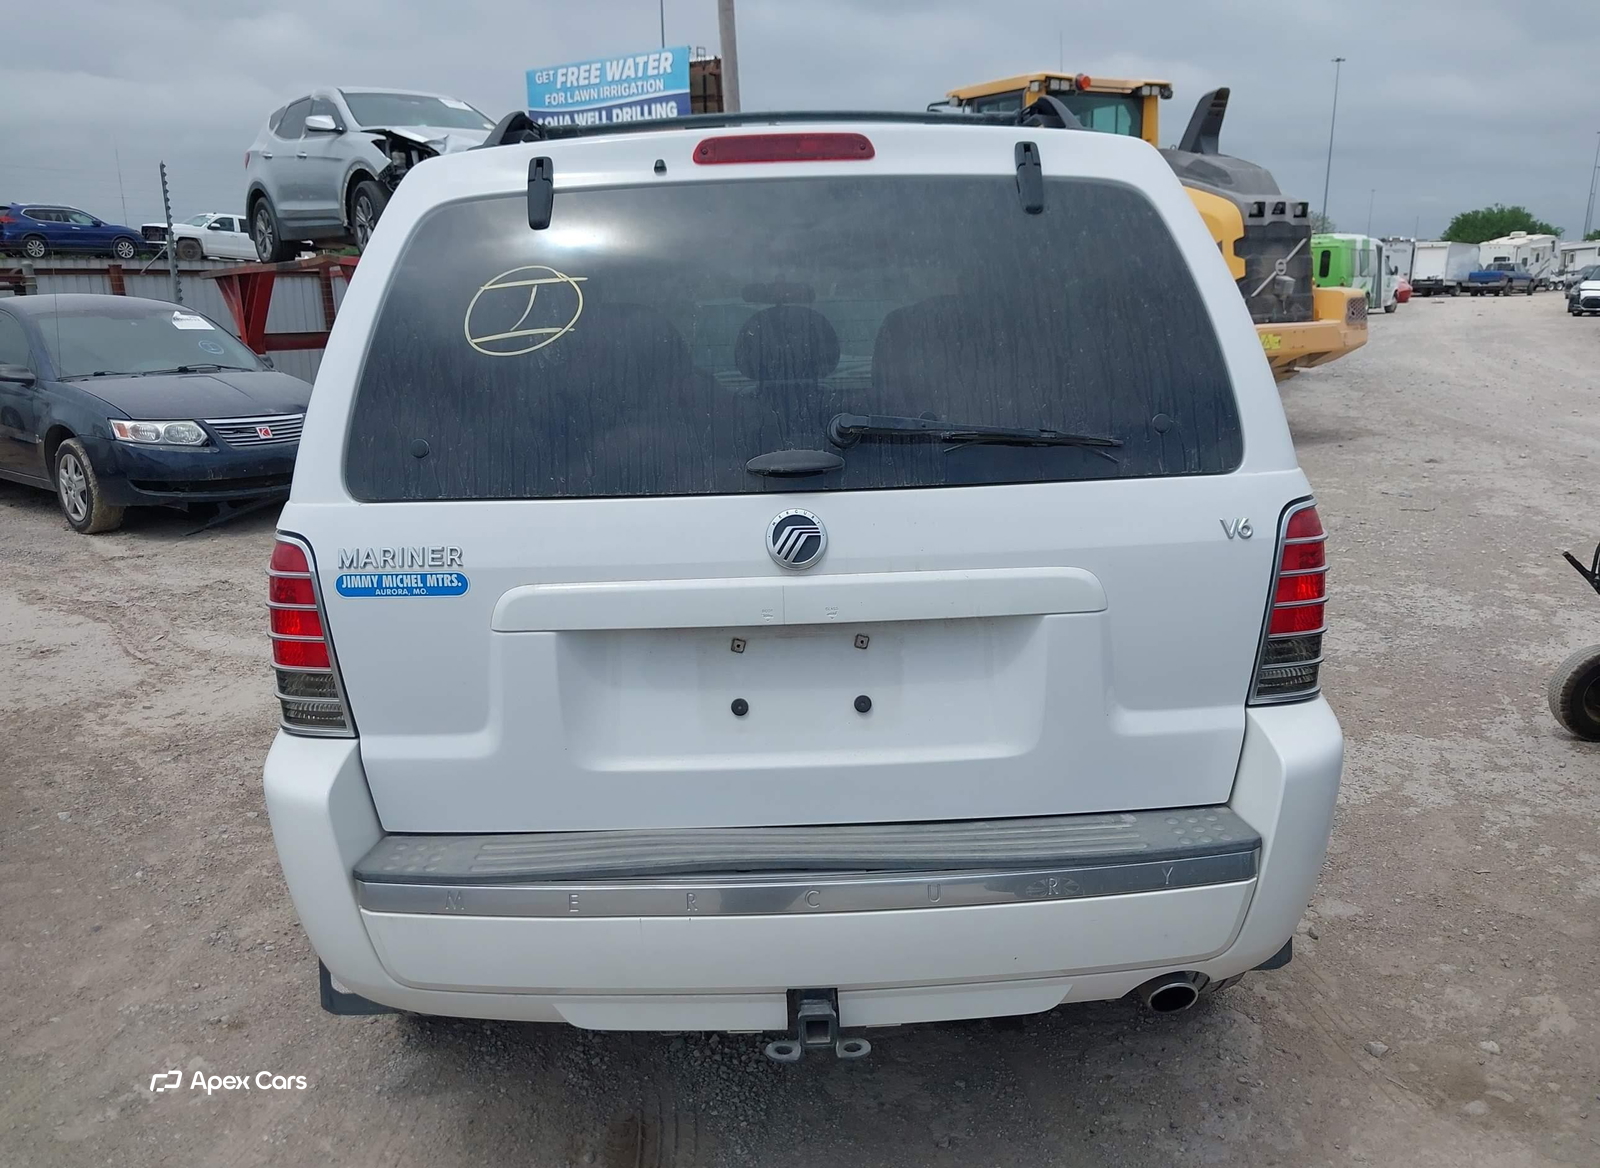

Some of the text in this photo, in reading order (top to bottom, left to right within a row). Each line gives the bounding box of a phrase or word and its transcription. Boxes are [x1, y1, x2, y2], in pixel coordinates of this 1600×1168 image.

[535, 51, 674, 89] GET FREE WATER
[545, 79, 664, 107] FOR LAWN IRRIGATION
[574, 109, 609, 126] WELL
[612, 101, 678, 123] DRILLING
[1219, 517, 1254, 540] V6
[338, 546, 464, 570] MARINER
[341, 573, 462, 589] JIMMY MICHEL MTRS.
[375, 588, 411, 596] AURORA,
